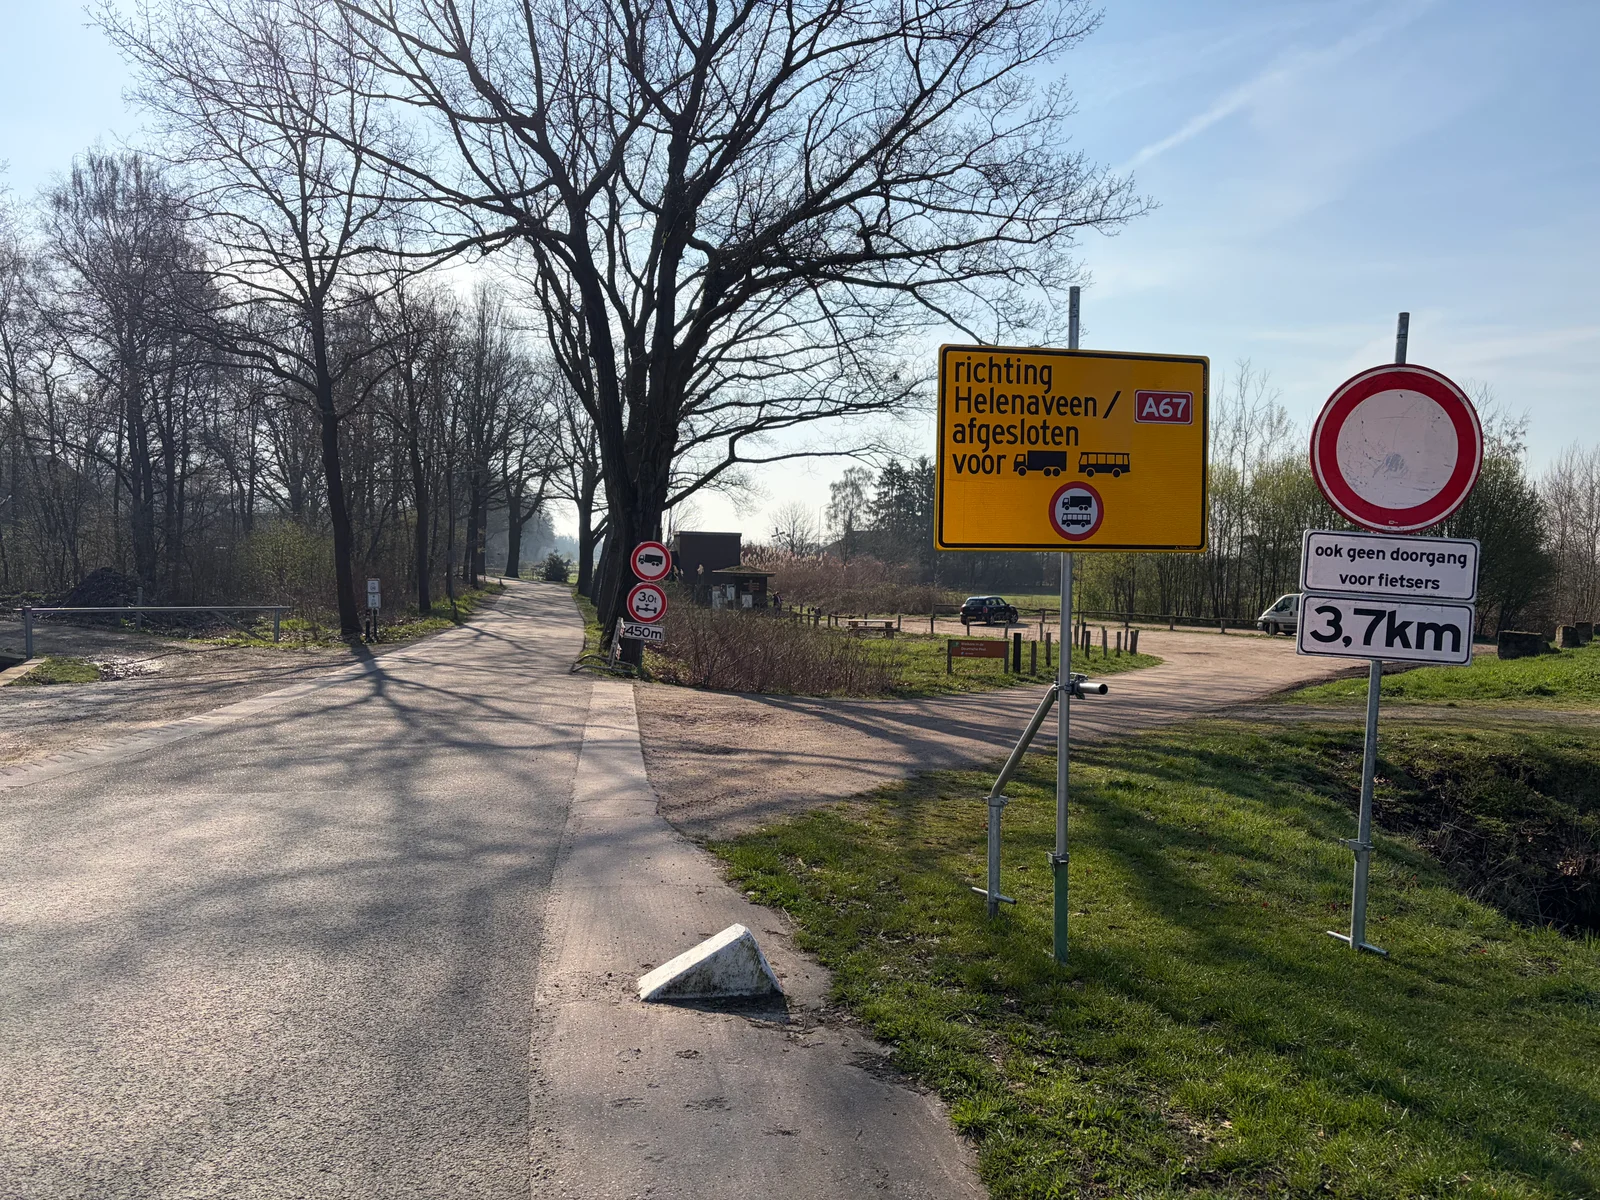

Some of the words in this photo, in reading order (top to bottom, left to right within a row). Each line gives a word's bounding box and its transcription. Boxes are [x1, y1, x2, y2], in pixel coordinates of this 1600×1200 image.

[955, 356, 1053, 394] richting
[955, 386, 1097, 417] Helenaveen
[1141, 397, 1188, 419] A67
[952, 417, 1079, 453] afgesloten
[952, 453, 1007, 475] voor
[1315, 544, 1344, 558] ook
[1347, 547, 1386, 563] geen
[1390, 547, 1468, 569] doorgang
[1339, 573, 1375, 586] voor
[1378, 573, 1440, 590] fietsers
[625, 626, 662, 640] 450m
[1309, 605, 1462, 653] 3,7km
